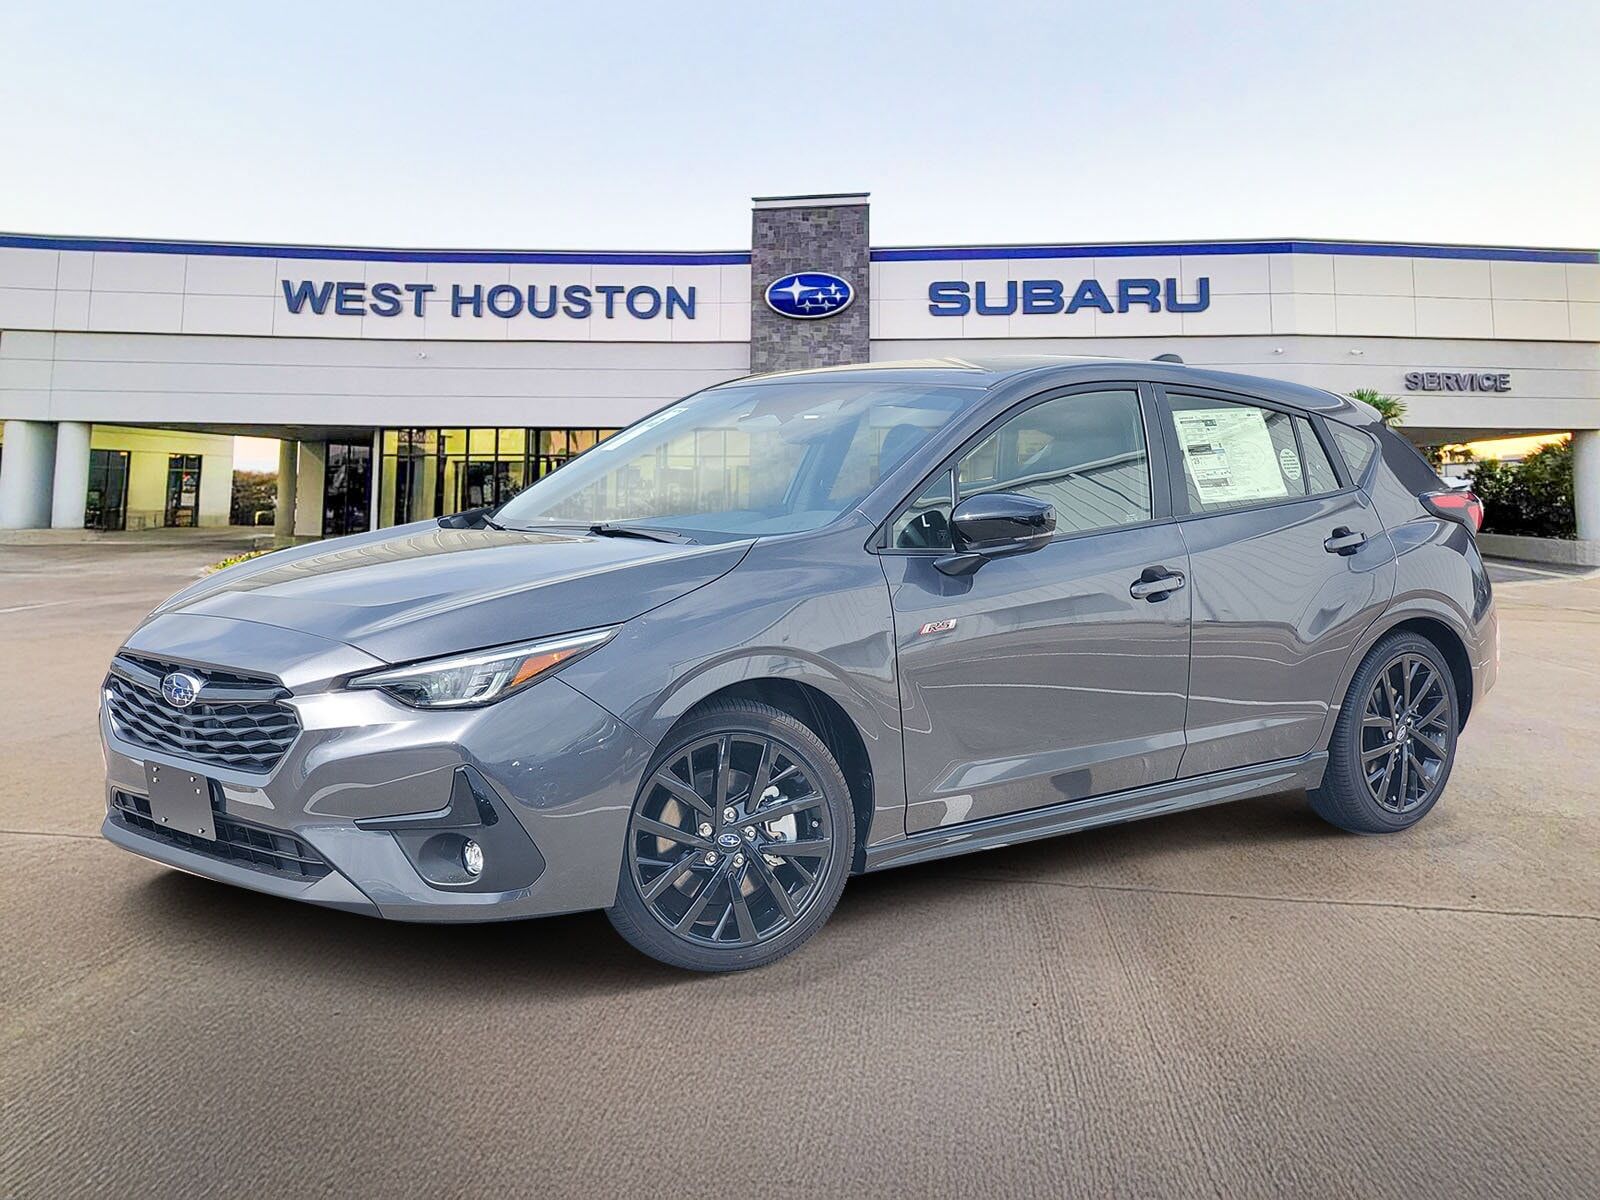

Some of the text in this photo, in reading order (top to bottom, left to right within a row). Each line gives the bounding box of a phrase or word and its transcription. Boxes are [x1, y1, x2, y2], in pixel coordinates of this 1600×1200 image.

[282, 280, 696, 319] WEST HOUSTON
[928, 277, 1210, 316] SUBARU
[1405, 372, 1511, 392] SERVICE
